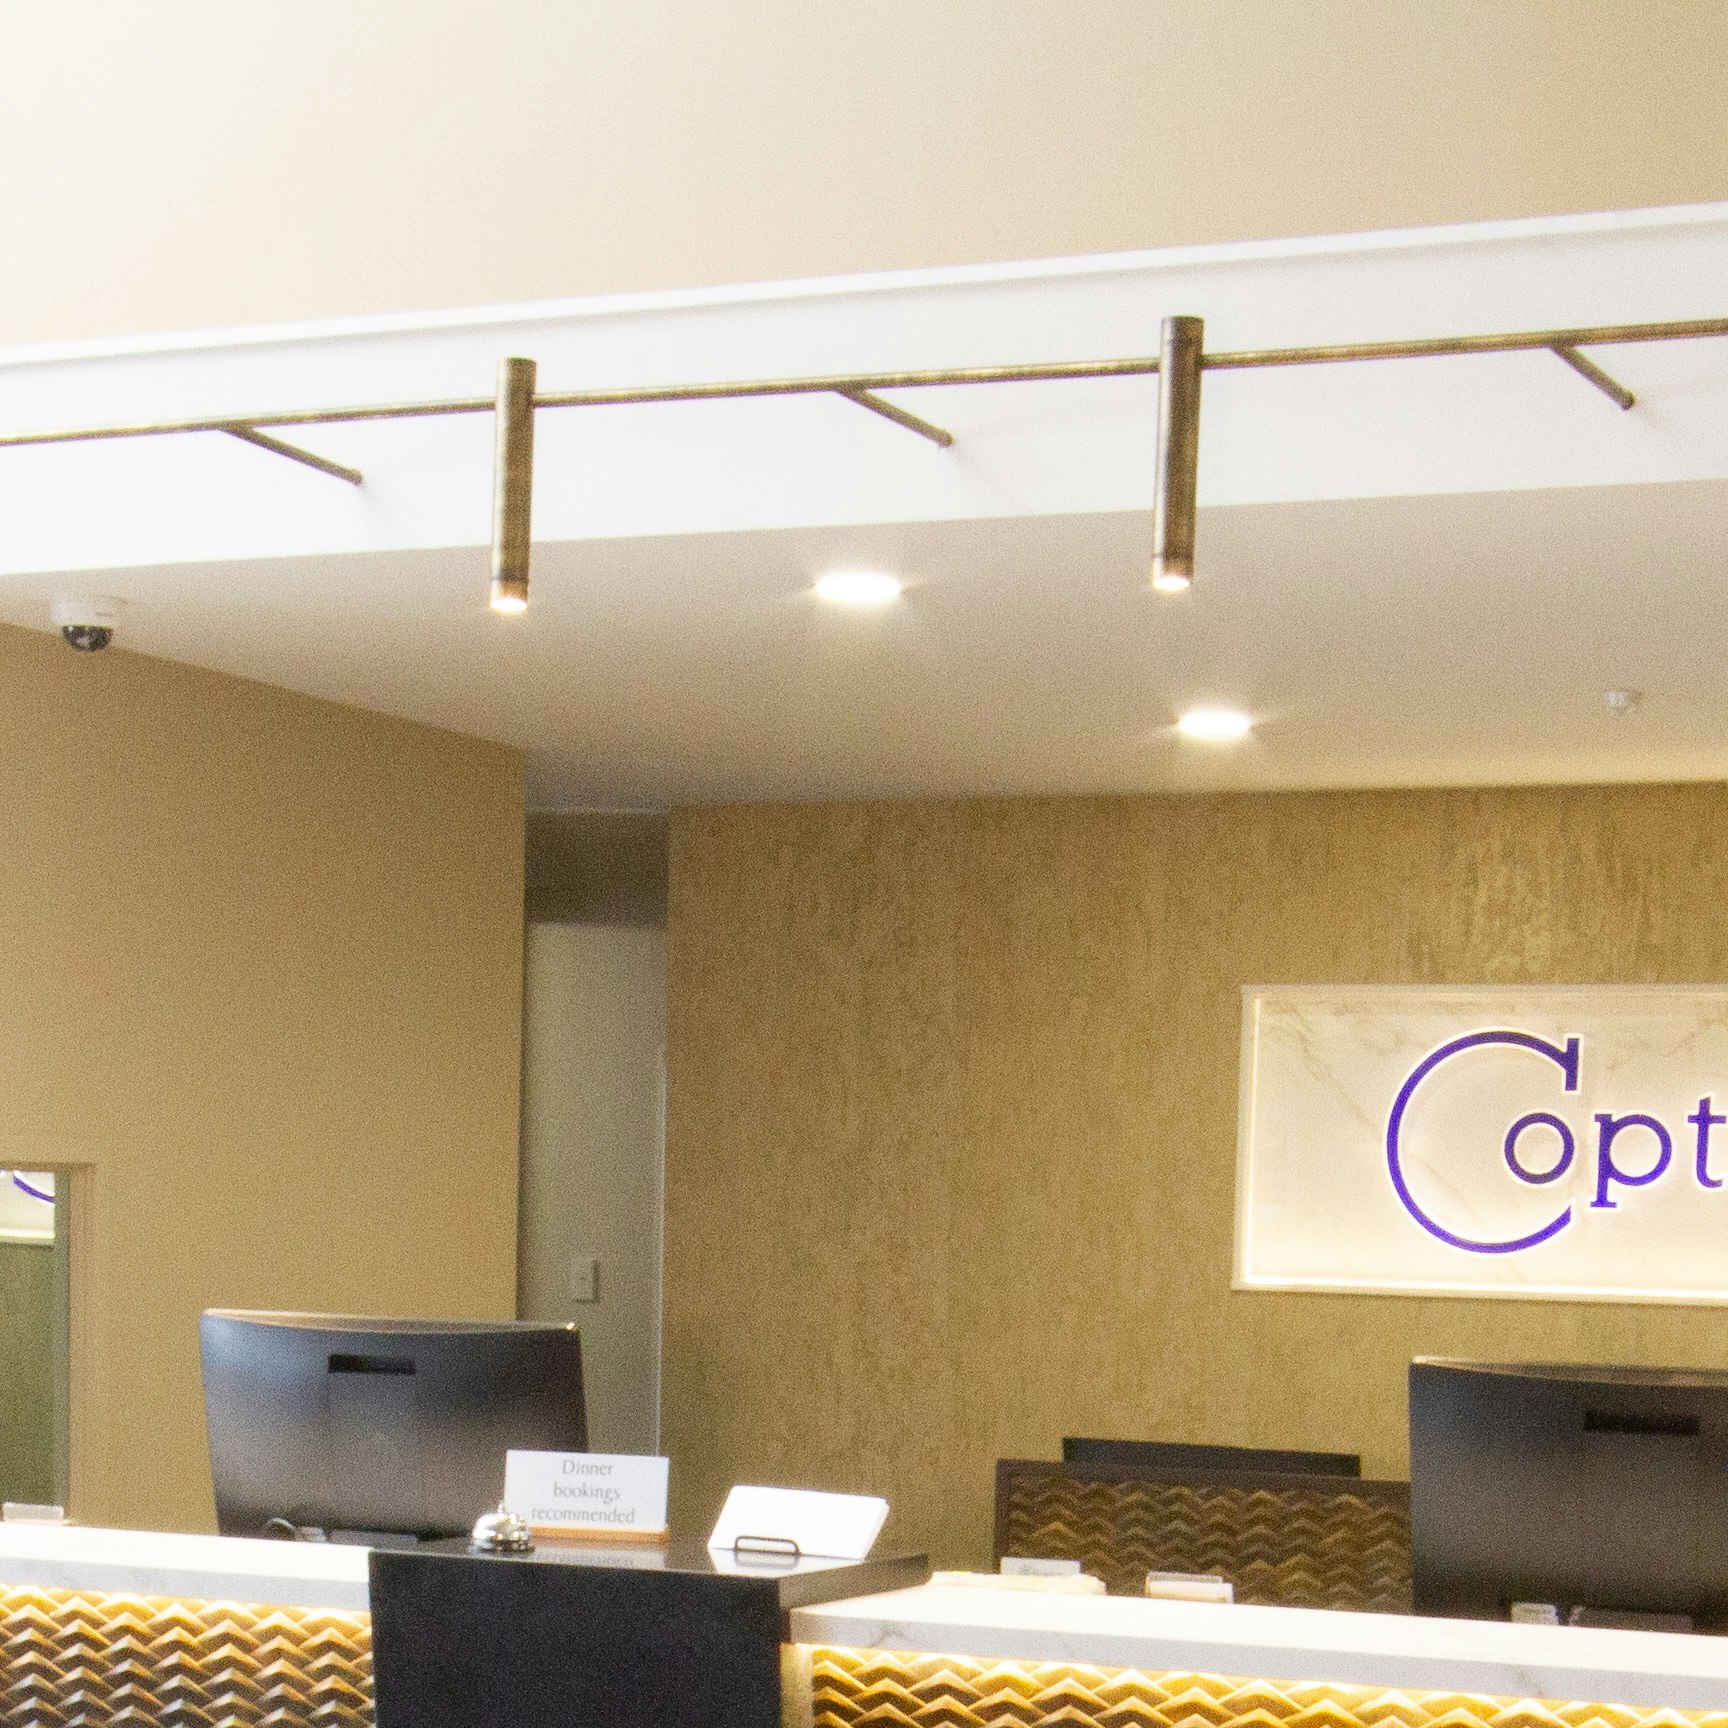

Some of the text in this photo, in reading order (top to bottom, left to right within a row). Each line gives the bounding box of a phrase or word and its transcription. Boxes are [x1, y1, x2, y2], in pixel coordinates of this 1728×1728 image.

[561, 1459, 614, 1476] Dinner
[552, 1482, 620, 1504] bookings
[530, 1508, 636, 1524] recommended
